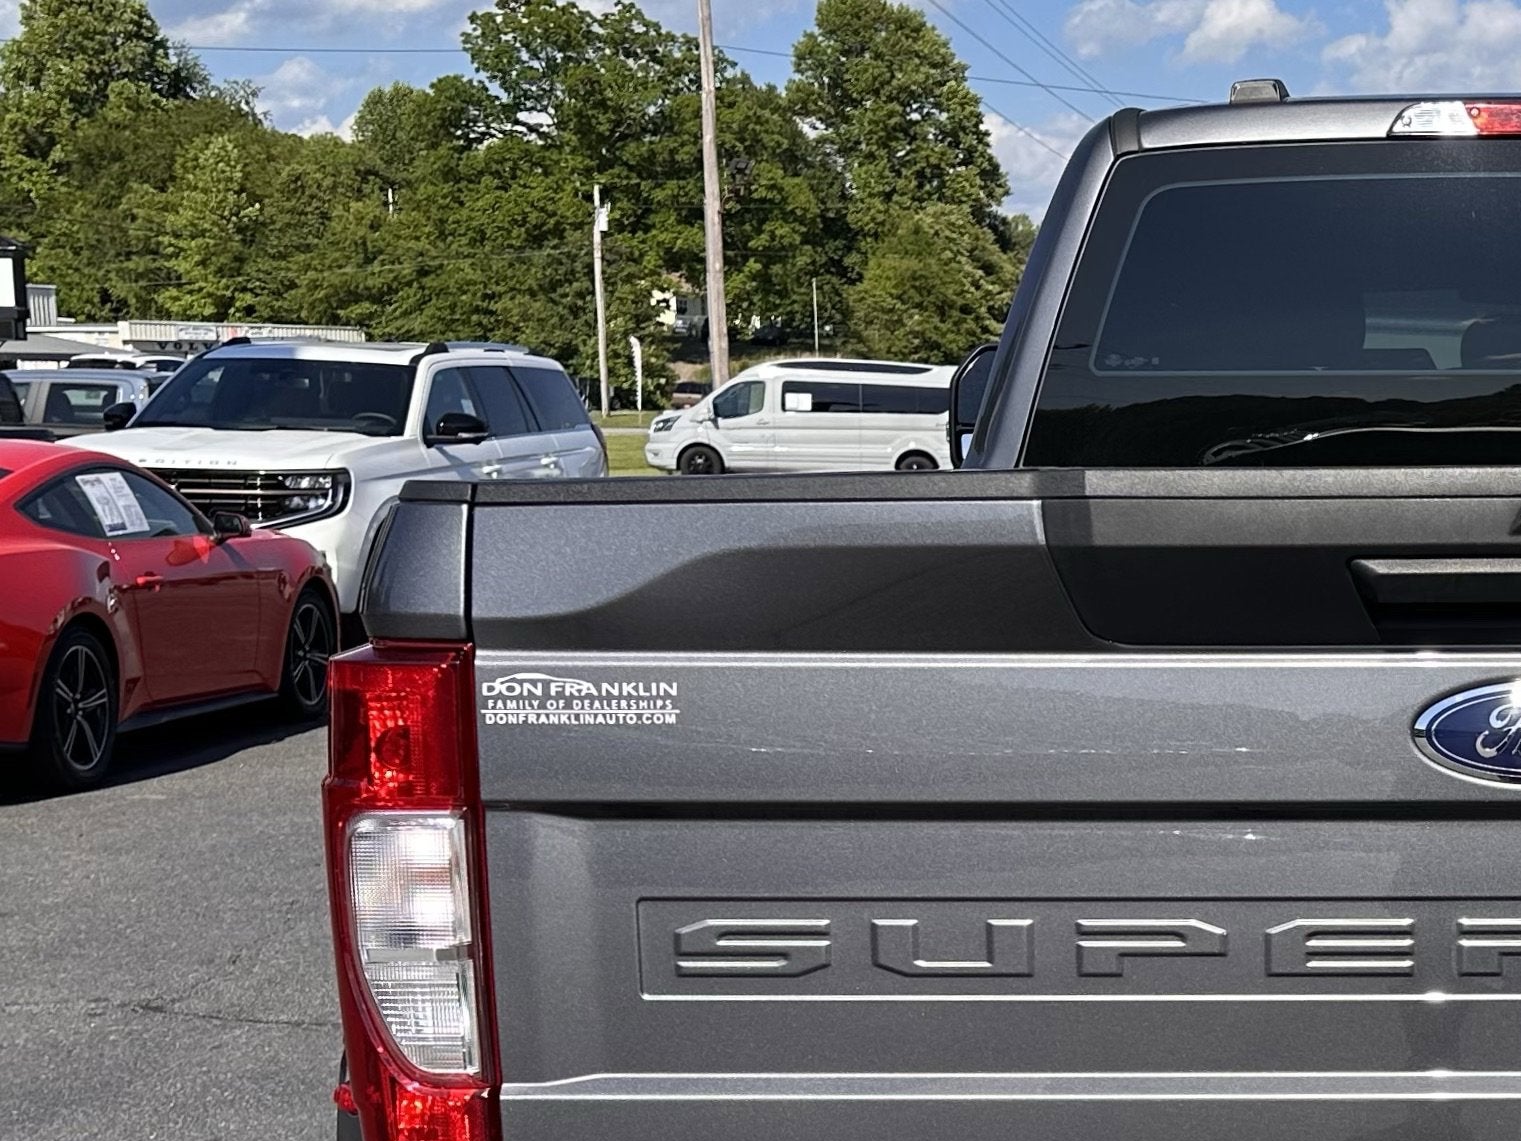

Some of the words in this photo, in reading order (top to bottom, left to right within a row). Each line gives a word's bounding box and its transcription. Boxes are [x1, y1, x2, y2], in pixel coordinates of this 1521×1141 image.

[481, 682, 543, 696] DON
[550, 682, 678, 696] FRANKLIN
[487, 699, 540, 710] FAMILY
[546, 699, 565, 710] OF
[571, 699, 673, 710] DEALERSHIPS
[485, 713, 677, 725] DONFRANKLINAUTO.COM
